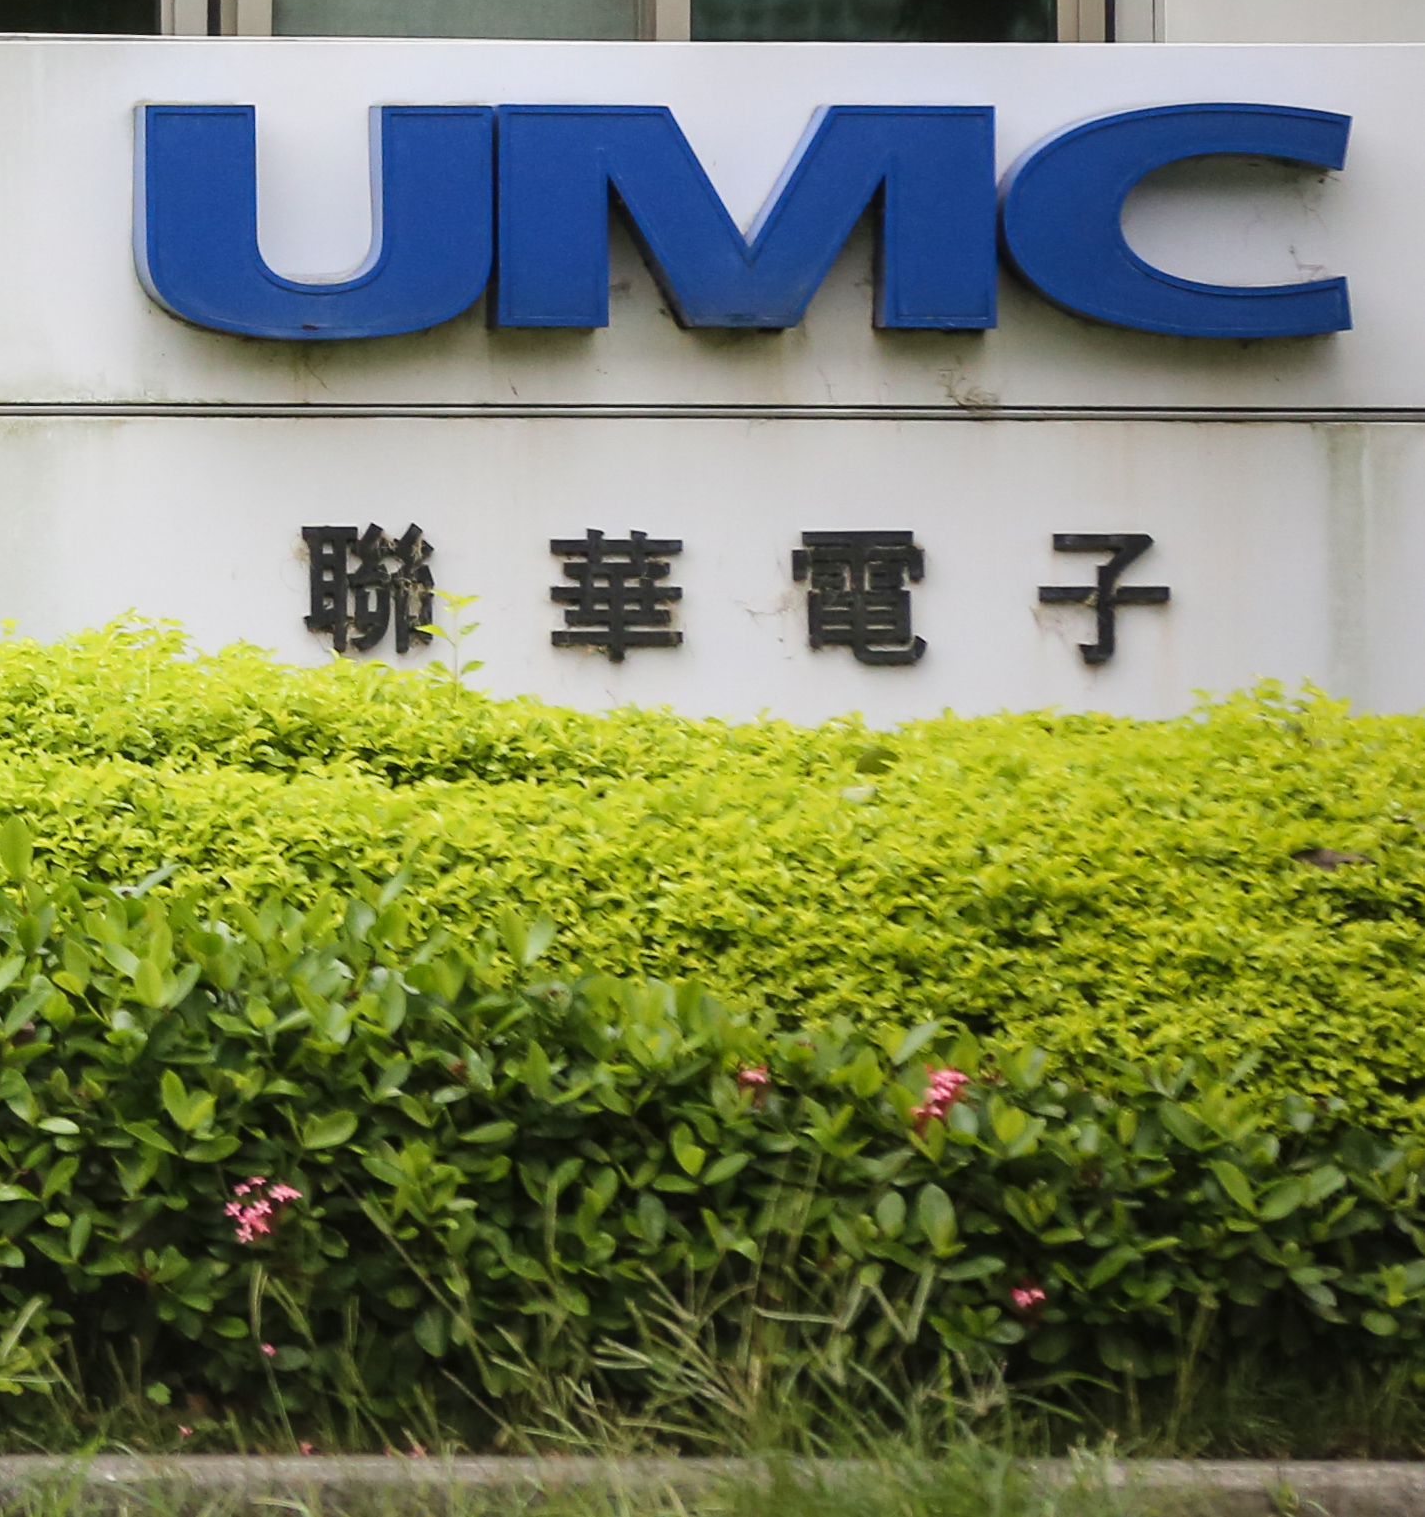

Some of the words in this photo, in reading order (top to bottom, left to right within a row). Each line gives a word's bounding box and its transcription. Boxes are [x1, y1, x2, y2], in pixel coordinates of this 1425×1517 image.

[134, 102, 1353, 341] UMC
[300, 522, 1171, 666] 聯華電子
